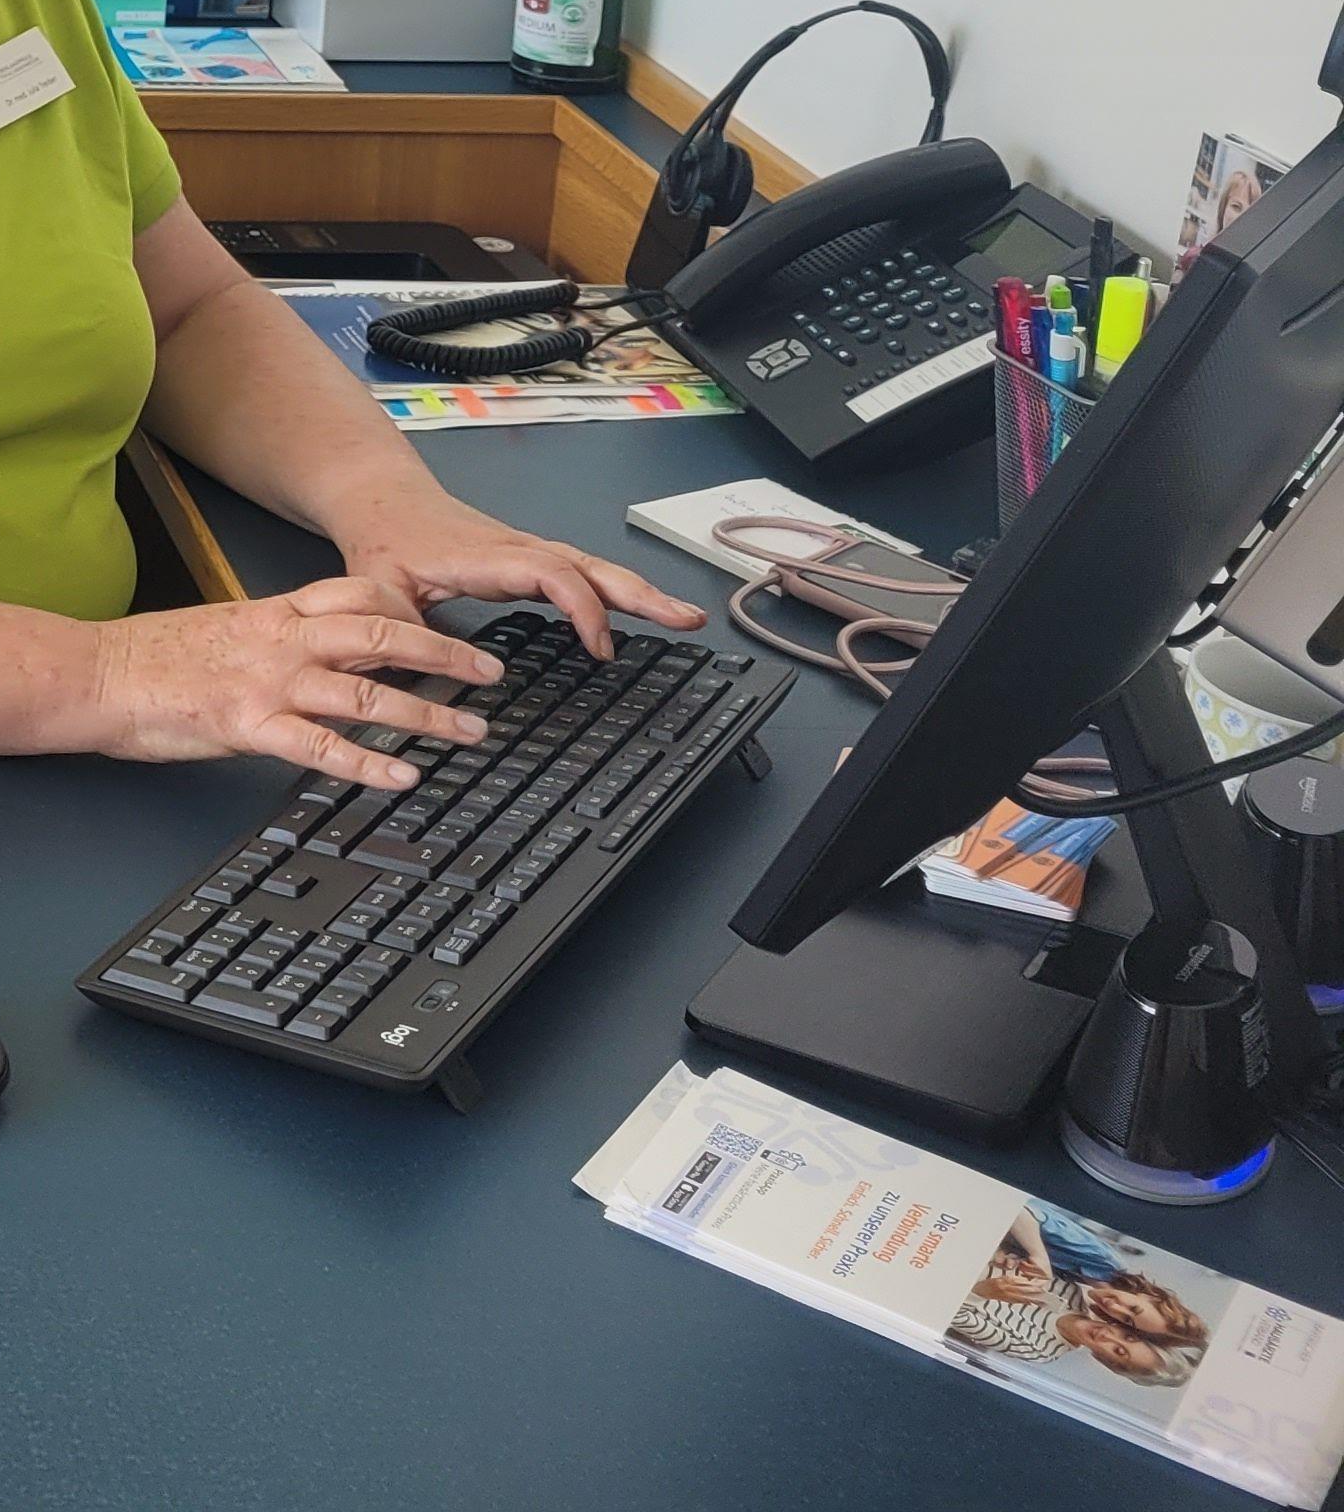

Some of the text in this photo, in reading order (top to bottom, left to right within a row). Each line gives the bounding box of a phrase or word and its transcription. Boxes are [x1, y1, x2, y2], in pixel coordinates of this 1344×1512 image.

[1016, 317, 1032, 355] essity
[197, 905, 213, 913] 0
[245, 968, 259, 976] 6
[379, 1024, 419, 1048] logi
[807, 1181, 872, 1259] Einfach. Schnell. Sicher.
[833, 1191, 901, 1277] zu unserer Praxis
[873, 1203, 932, 1263] Verbindung
[909, 1213, 960, 1269] Die smarte
